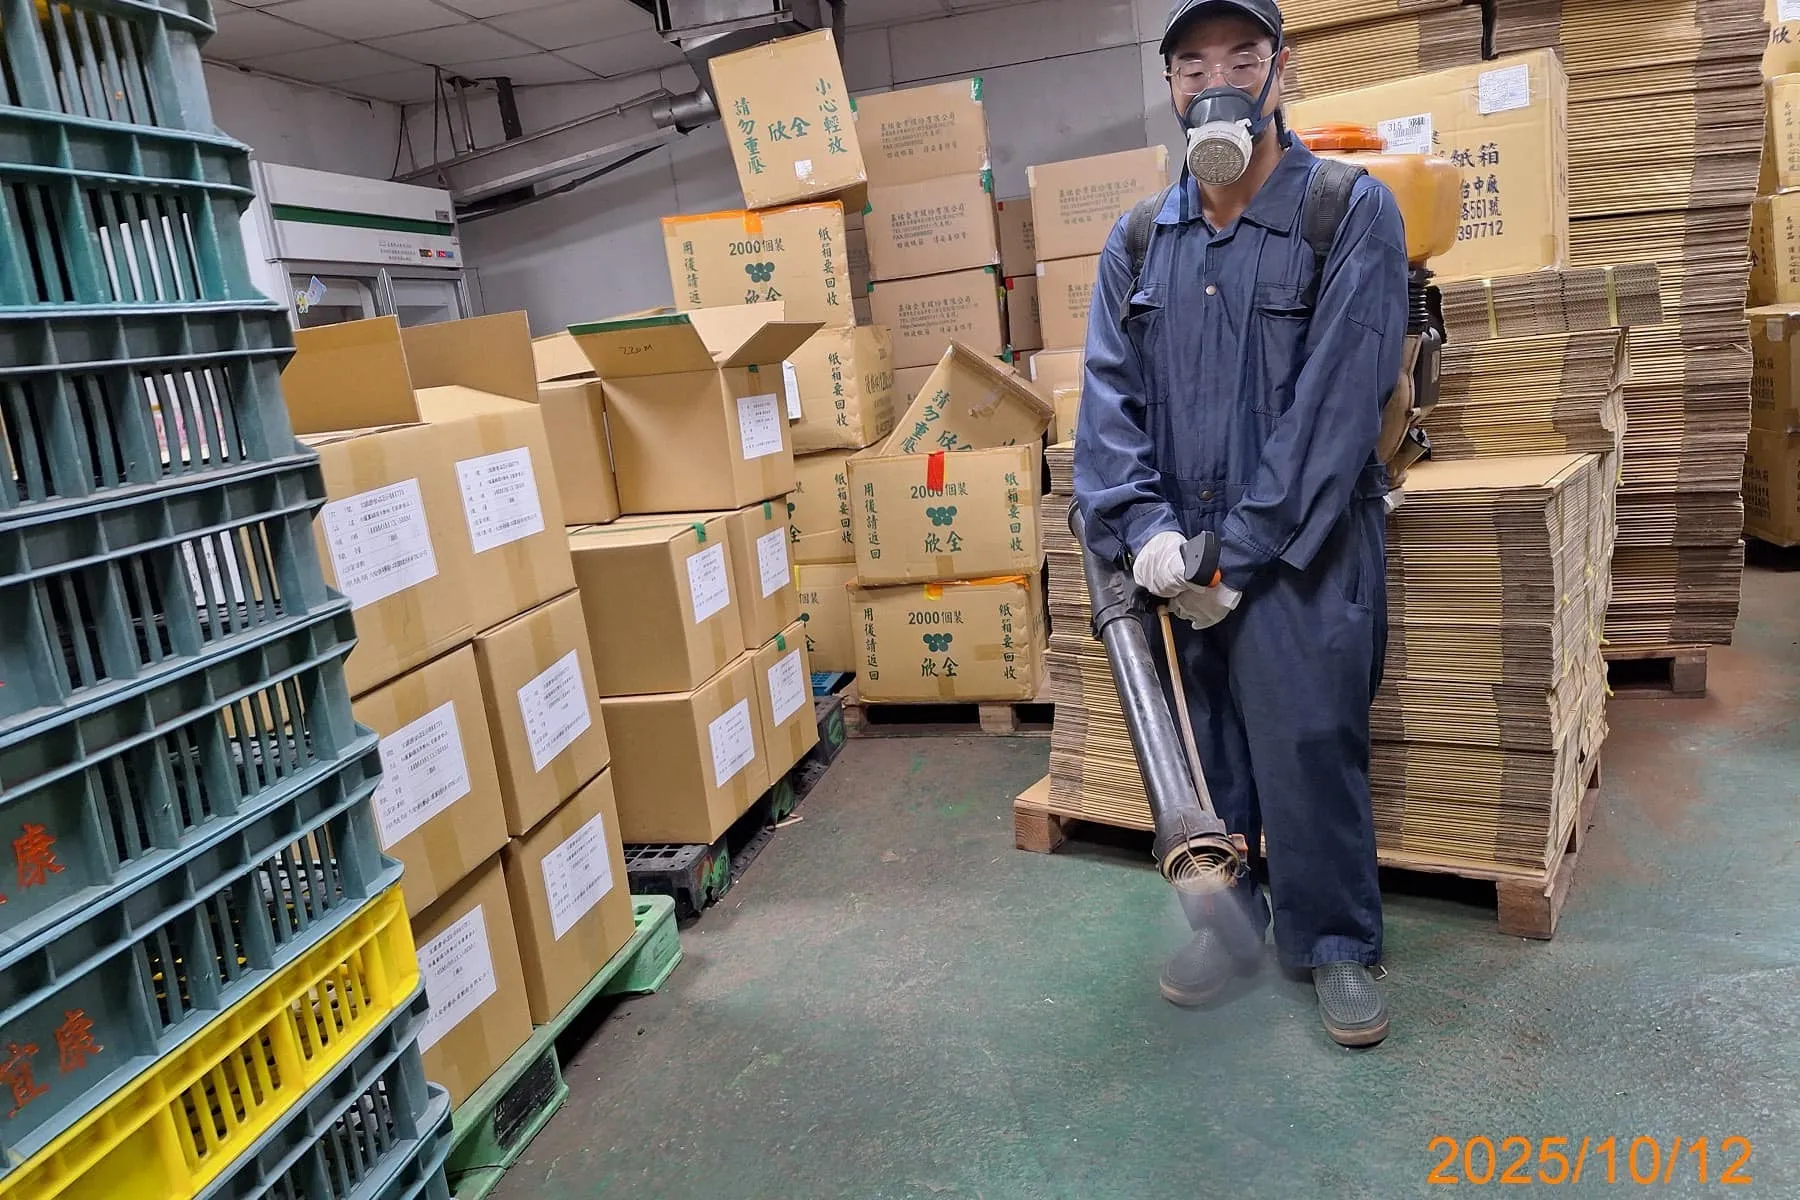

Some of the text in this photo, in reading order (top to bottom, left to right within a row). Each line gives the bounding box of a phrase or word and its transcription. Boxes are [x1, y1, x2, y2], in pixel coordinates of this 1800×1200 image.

[734, 96, 767, 175] 請勿重壓
[767, 116, 811, 142] 欣全
[815, 77, 848, 154] 小心輕放
[728, 238, 785, 256] 2000個裝
[1458, 219, 1503, 240] 397712
[682, 240, 702, 309] 用後請返
[818, 227, 839, 306] 紙箱要回收
[828, 352, 848, 427] 紙箱要回收
[834, 473, 853, 544] 紙箱要回收
[864, 483, 881, 559] 用後請返回
[924, 531, 963, 553] 欣全
[1004, 472, 1023, 552] 紙箱要回收
[864, 608, 880, 681] 用後請返回
[908, 610, 964, 625] 2000個裝
[999, 603, 1017, 680] 紙箱要回收
[921, 657, 959, 677] 欣全
